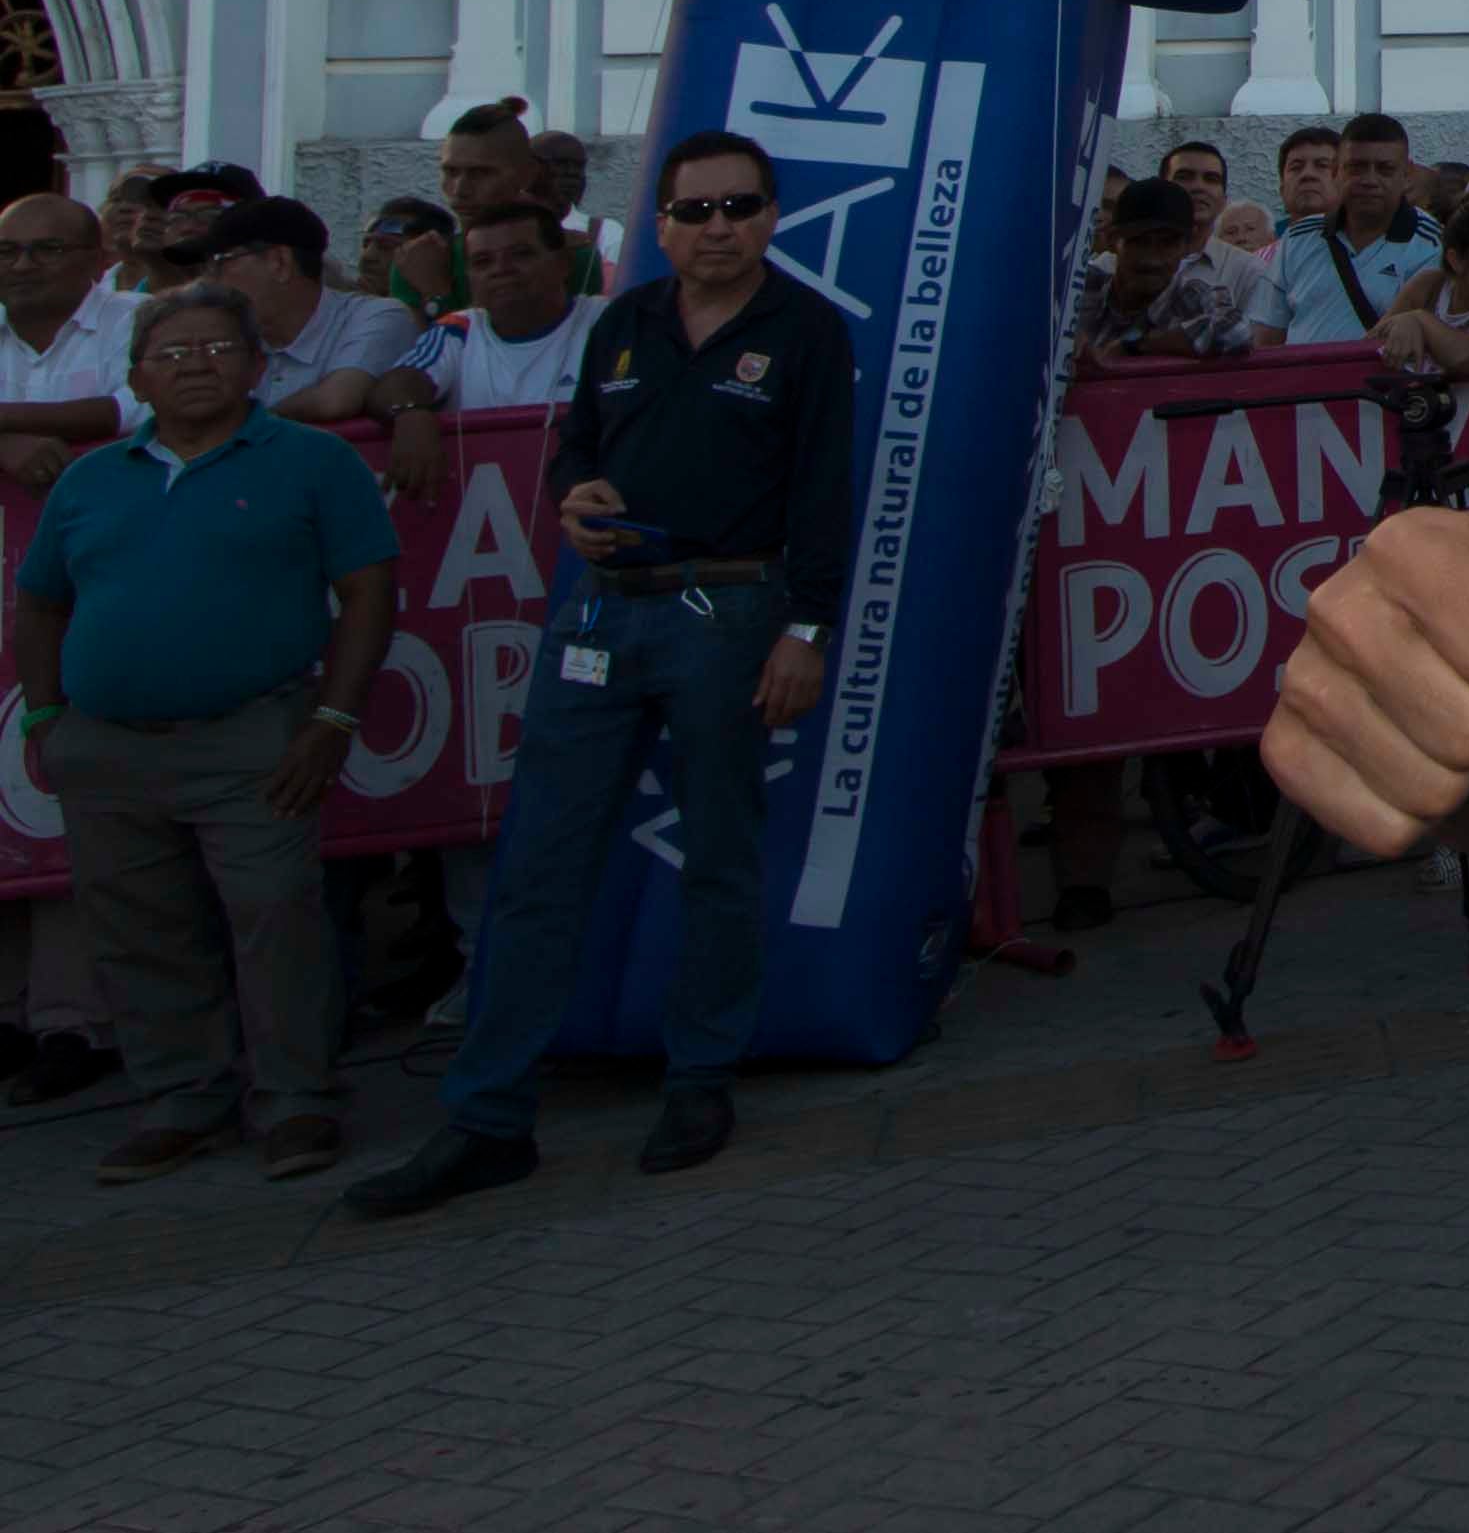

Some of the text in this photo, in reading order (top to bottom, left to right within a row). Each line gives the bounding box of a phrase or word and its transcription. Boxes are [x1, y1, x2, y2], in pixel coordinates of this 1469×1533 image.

[822, 159, 964, 818] La cultura natural de la belleza
